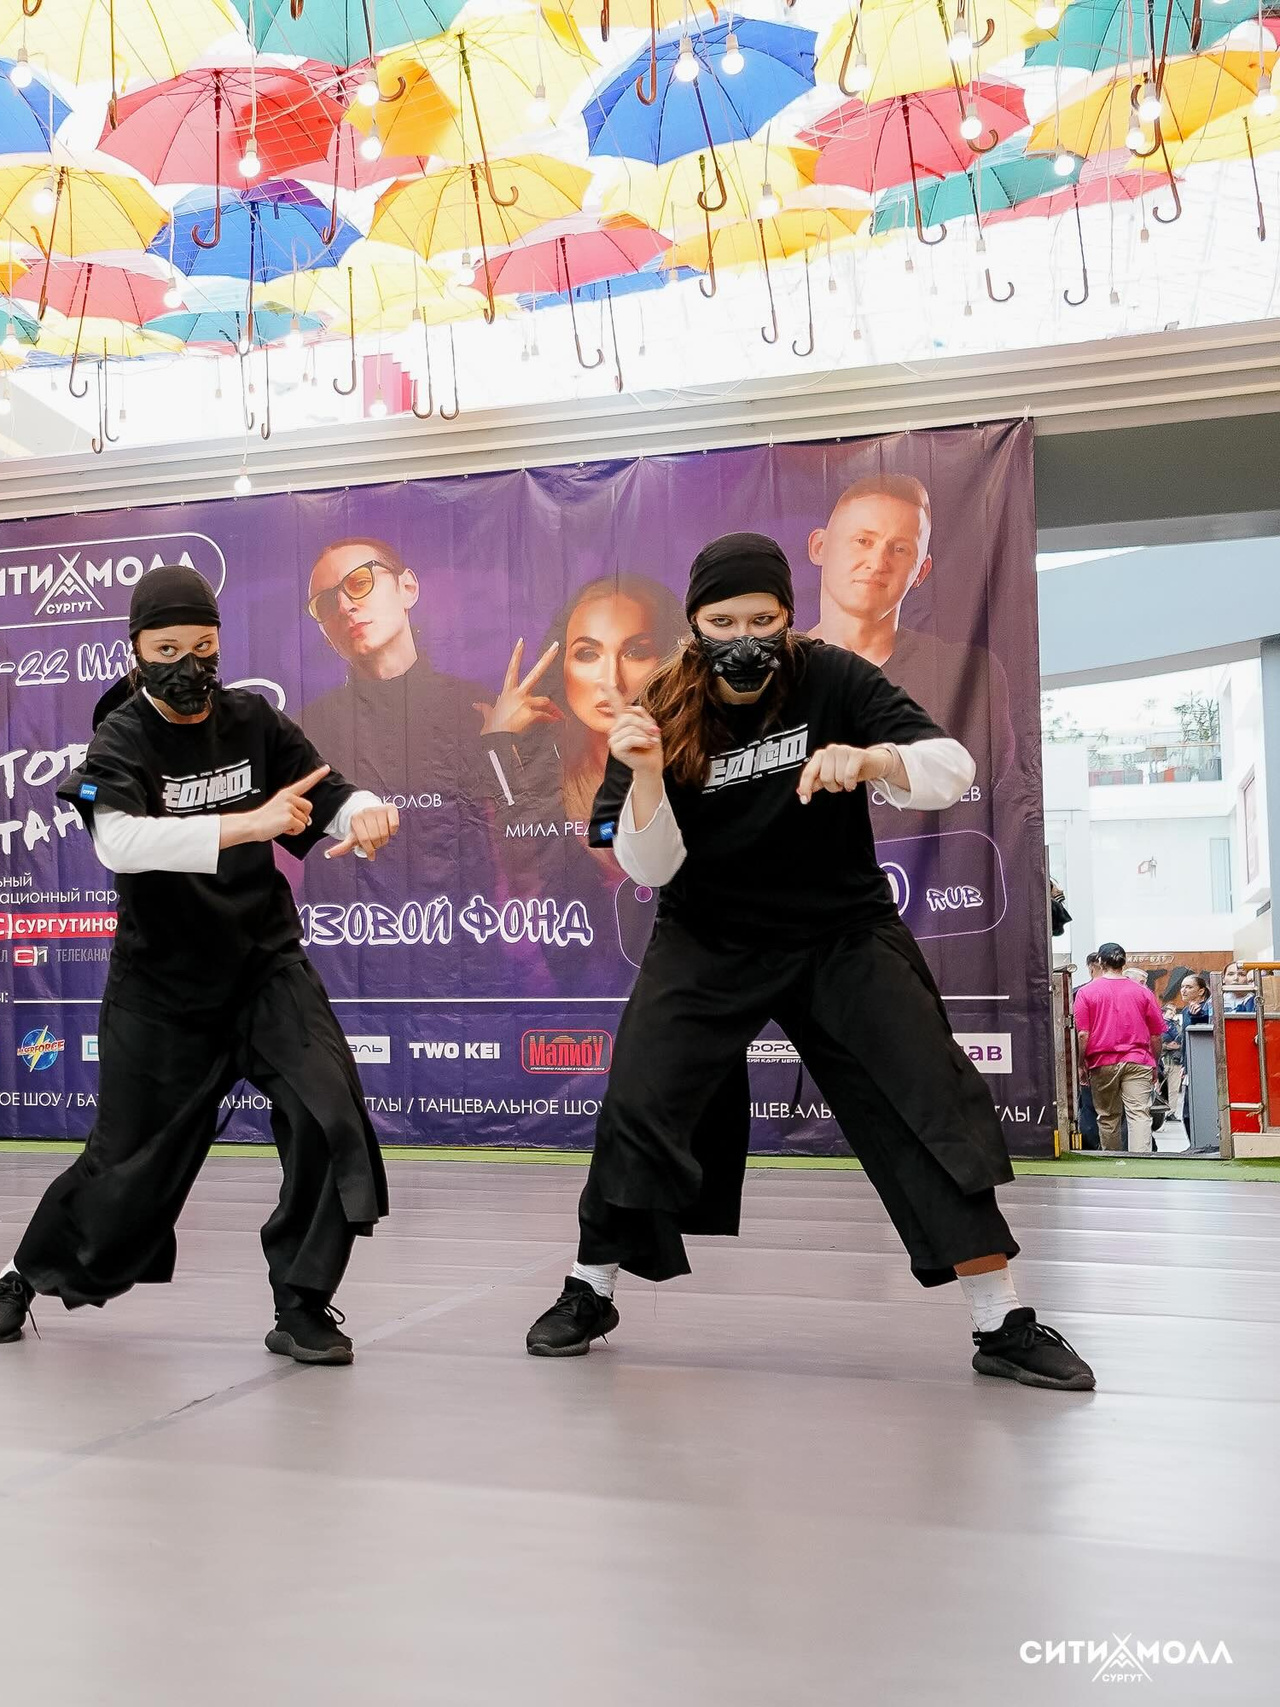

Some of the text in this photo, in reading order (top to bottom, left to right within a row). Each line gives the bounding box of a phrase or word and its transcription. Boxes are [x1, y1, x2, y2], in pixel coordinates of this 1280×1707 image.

[46, 601, 93, 615] СУРГУТ
[505, 822, 559, 838] МИЛА
[85, 890, 120, 905] пар
[926, 885, 984, 912] RUB
[460, 895, 594, 946] ФОНД
[409, 1043, 500, 1059] TWO KEI
[24, 1092, 61, 1107] ШОУ
[77, 1093, 99, 1107] БА
[418, 1098, 558, 1116] ТАНЦЕВАЛЬНОЕ
